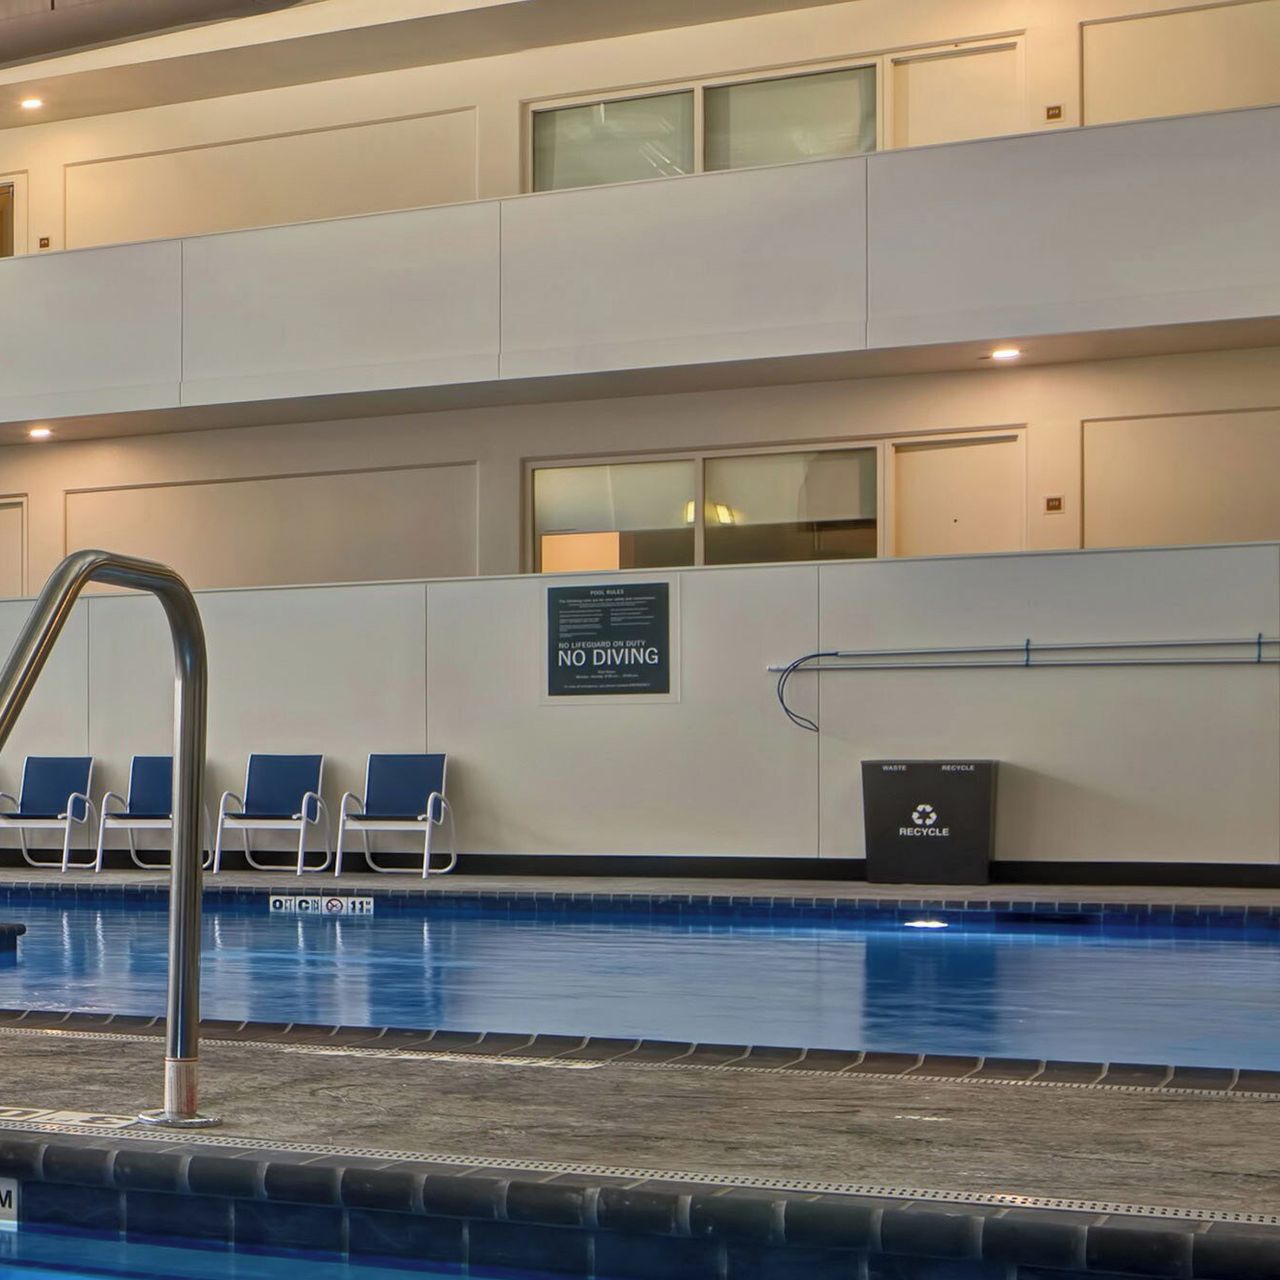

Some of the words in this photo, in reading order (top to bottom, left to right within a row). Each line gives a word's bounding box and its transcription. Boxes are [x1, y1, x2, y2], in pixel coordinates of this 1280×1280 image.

[558, 649, 586, 667] NO
[593, 647, 659, 665] DIVING
[899, 827, 949, 836] RECYCLE
